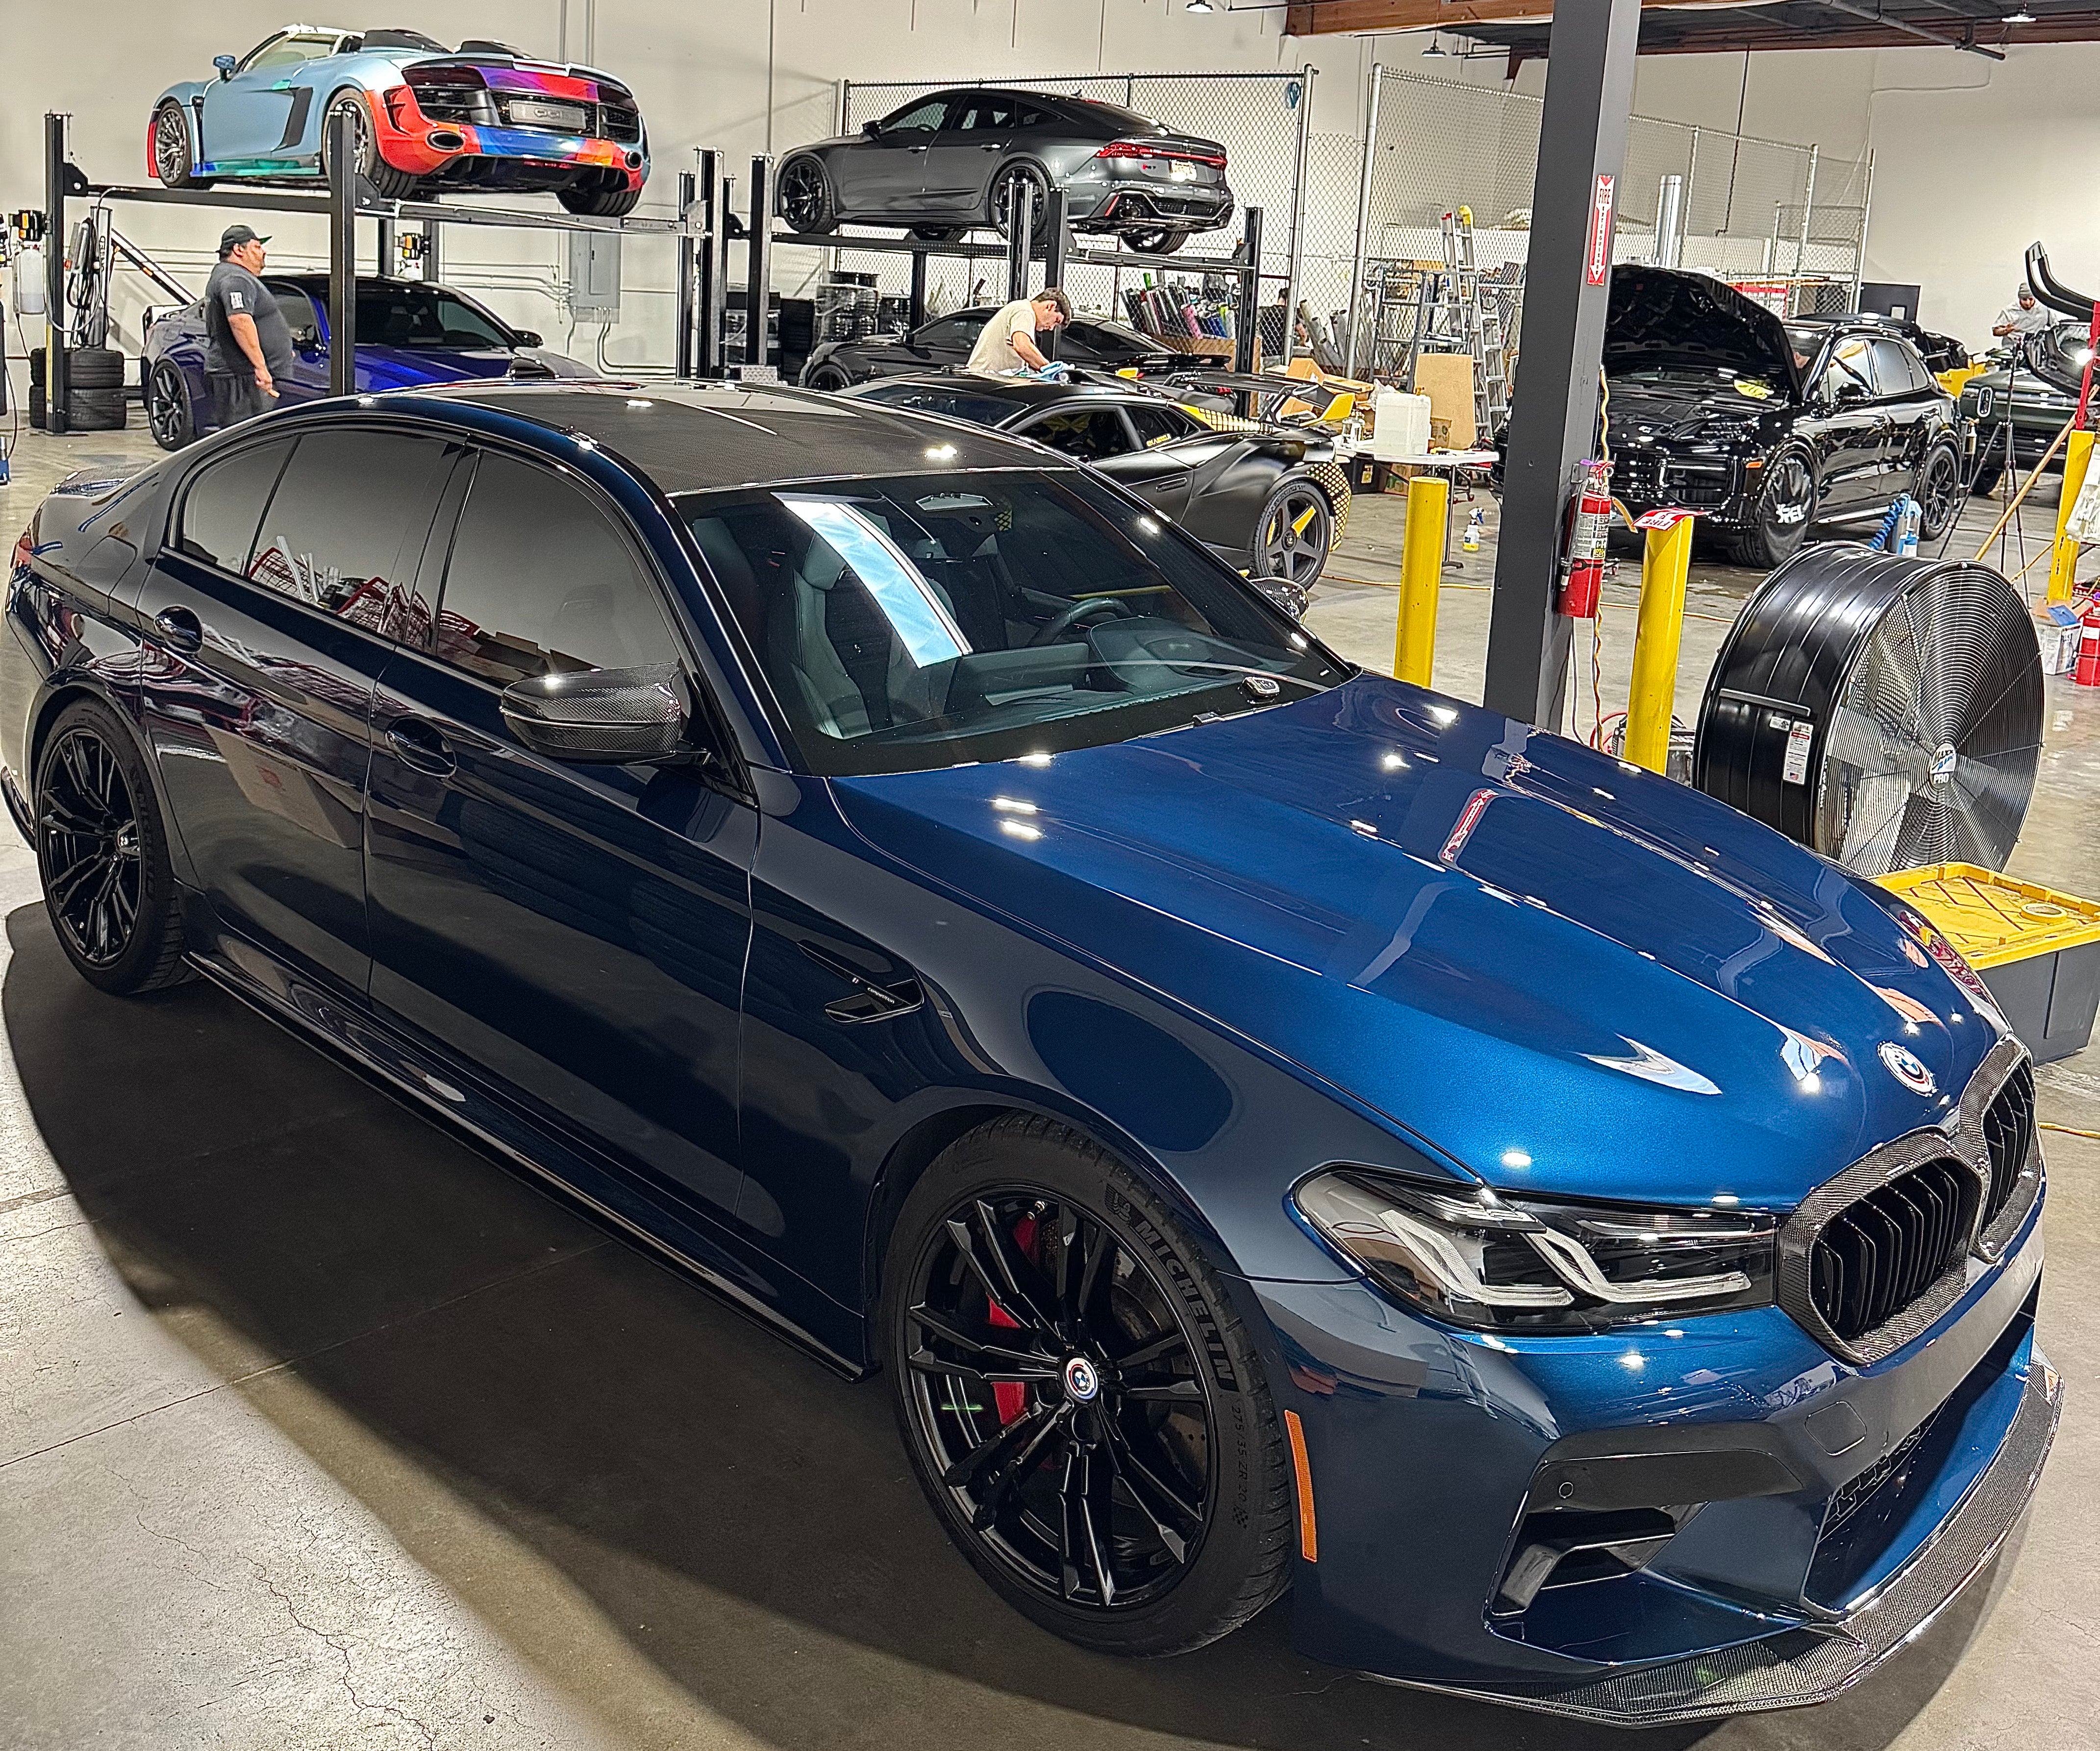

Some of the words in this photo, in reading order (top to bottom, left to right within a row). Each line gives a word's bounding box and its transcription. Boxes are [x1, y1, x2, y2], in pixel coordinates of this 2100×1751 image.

[1599, 188, 1611, 204] FIRE
[1642, 518, 1671, 527] FIRE
[1933, 773, 1950, 784] PRO
[1136, 1222, 1235, 1381] MICHELIN
[1238, 1461, 1248, 1480] ZR
